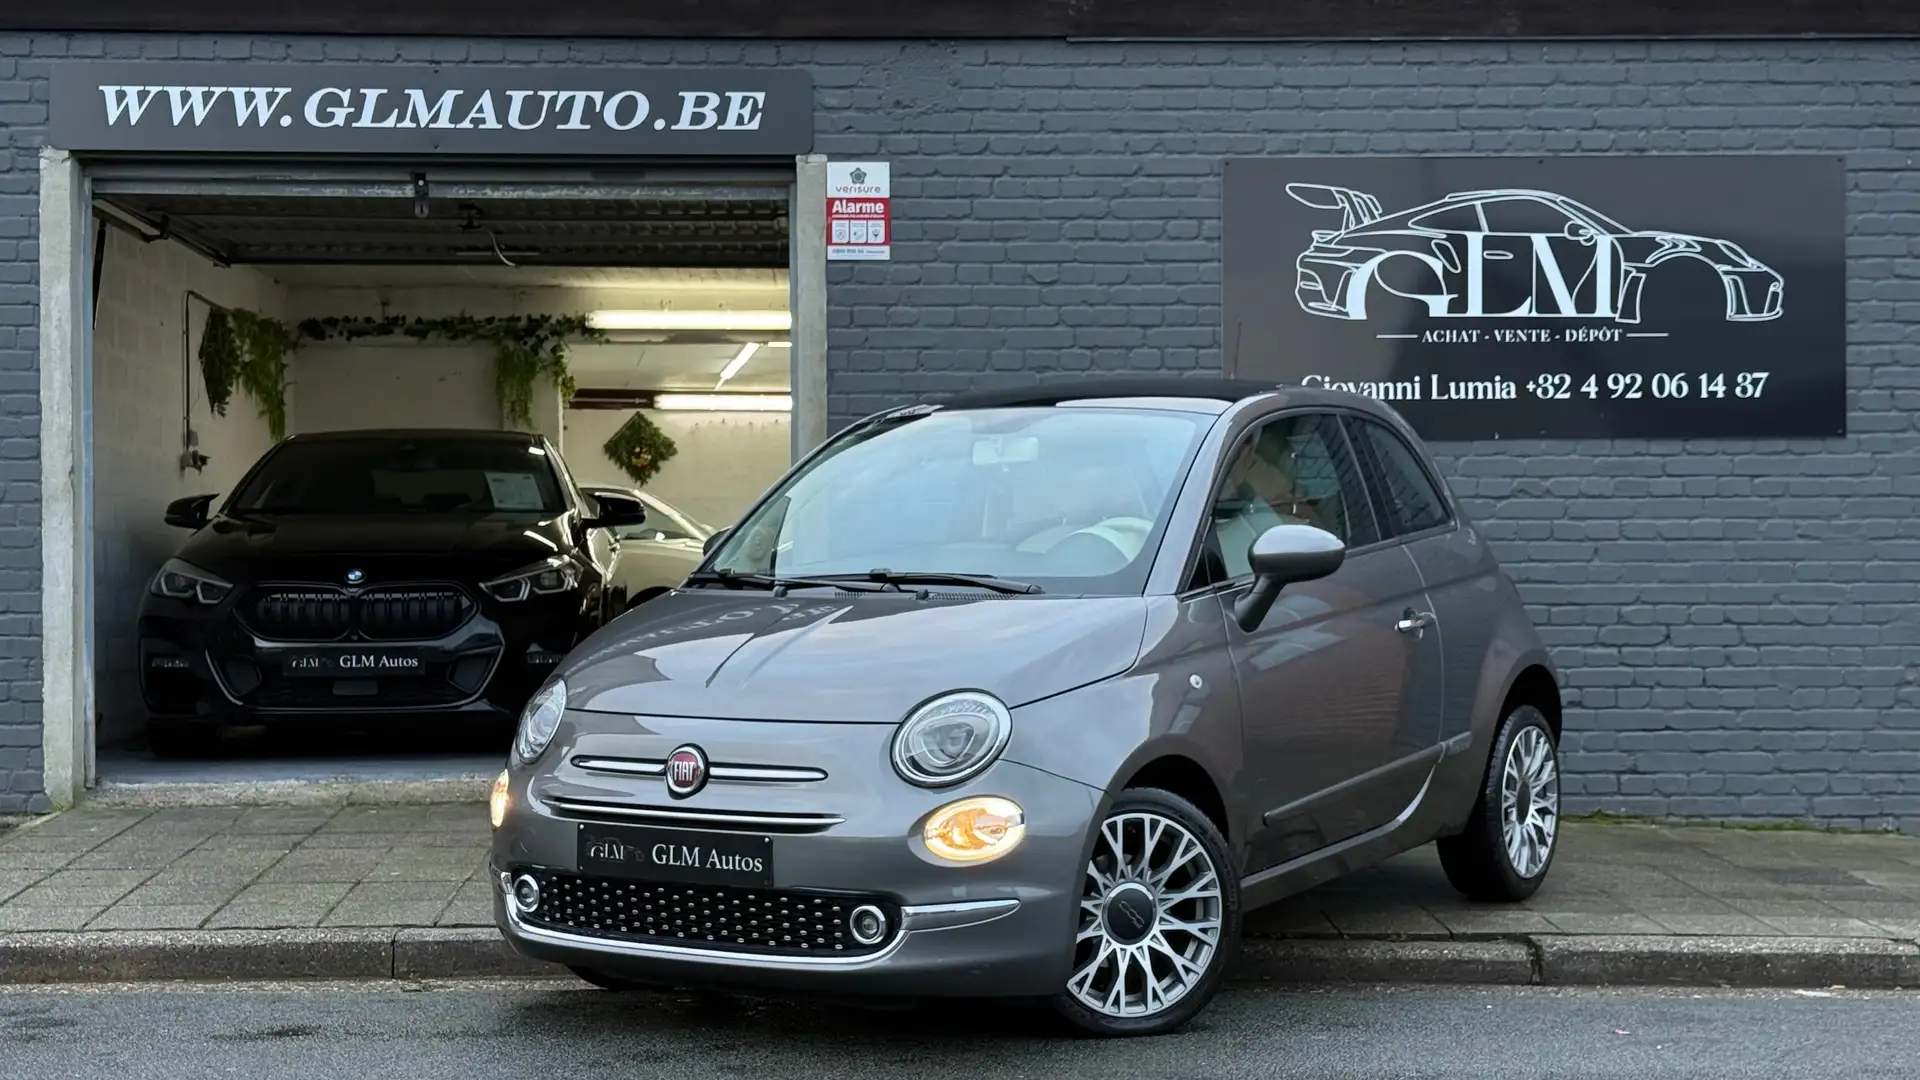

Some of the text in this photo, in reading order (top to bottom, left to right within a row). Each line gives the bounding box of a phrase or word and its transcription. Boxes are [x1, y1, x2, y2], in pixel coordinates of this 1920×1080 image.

[98, 85, 766, 132] WWW.GLMAUTO.BE
[832, 199, 885, 214] Alarme
[1421, 328, 1481, 344] ACHAT
[1493, 327, 1551, 343] VENTE
[1564, 325, 1623, 343] DÉPÔT
[1430, 373, 1517, 400] Lumia
[1525, 373, 1572, 399] +32
[1579, 373, 1599, 399] 4
[1606, 373, 1643, 399] 92
[1651, 372, 1690, 399] 06
[1698, 372, 1727, 398] 14
[1734, 371, 1770, 399] 37
[339, 655, 375, 668] GLM
[378, 655, 419, 667] Autos
[674, 760, 696, 781] FIAT
[652, 843, 701, 868] GLM
[705, 848, 764, 873] Autos
